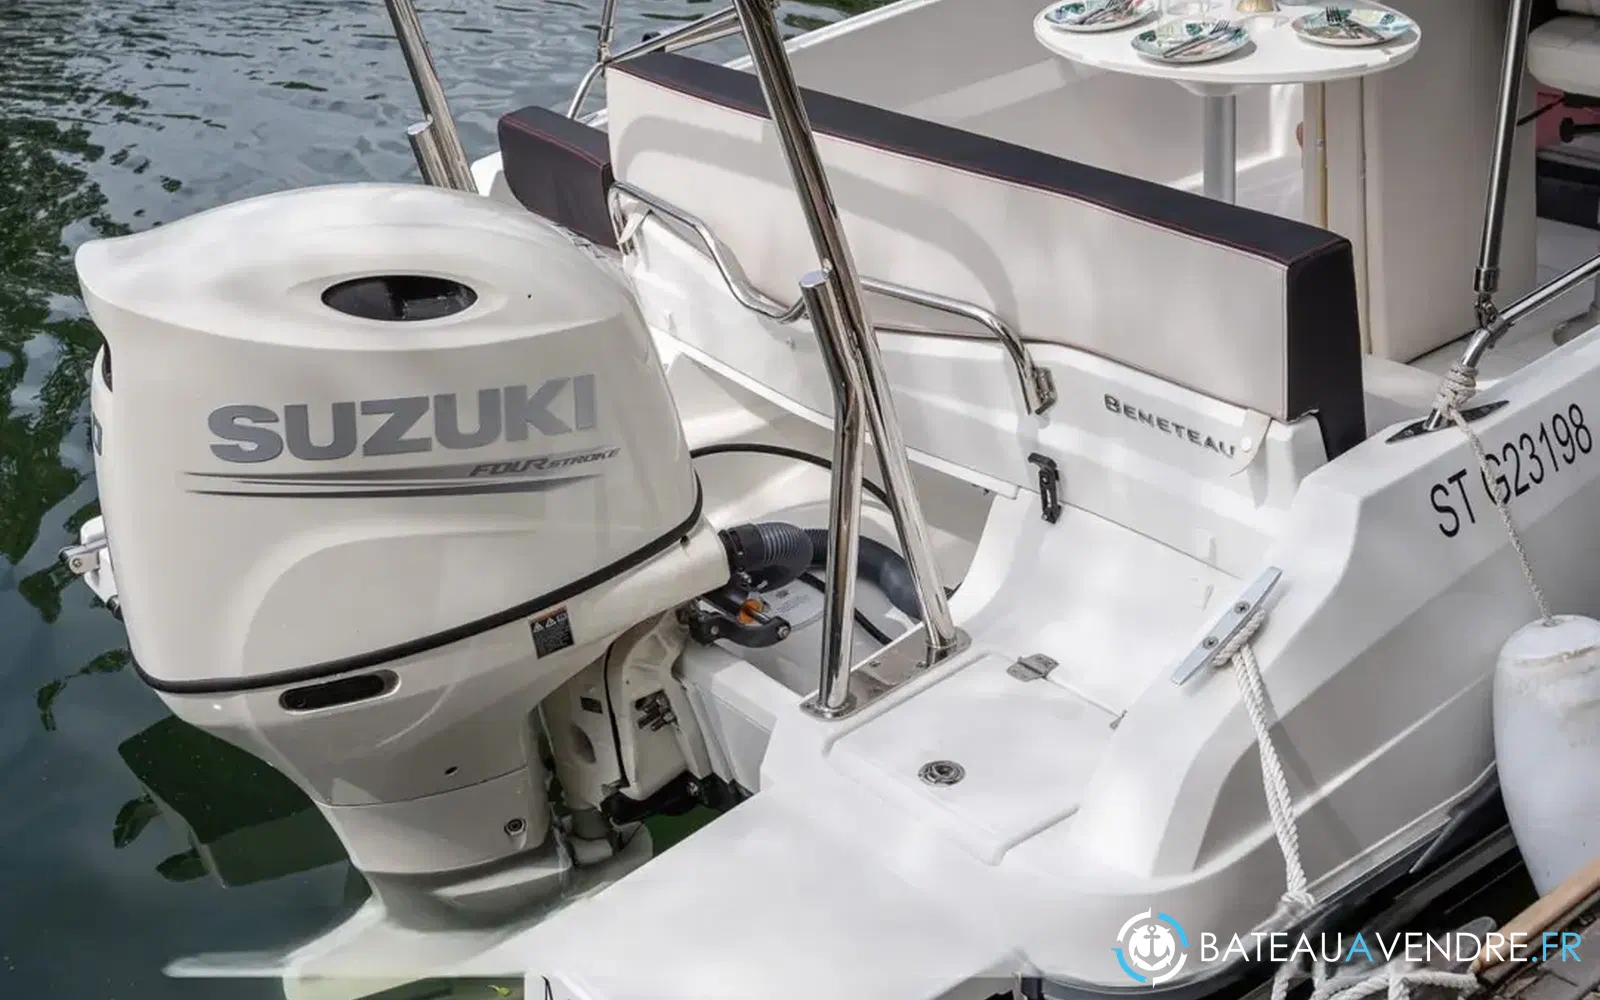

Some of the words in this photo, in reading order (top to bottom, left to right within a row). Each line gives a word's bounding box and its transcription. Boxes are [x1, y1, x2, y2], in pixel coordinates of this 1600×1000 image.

[207, 374, 597, 463] SUZUKI
[1104, 393, 1235, 459] BENETEAU
[1430, 468, 1476, 538] ST
[1480, 403, 1593, 505] G23198
